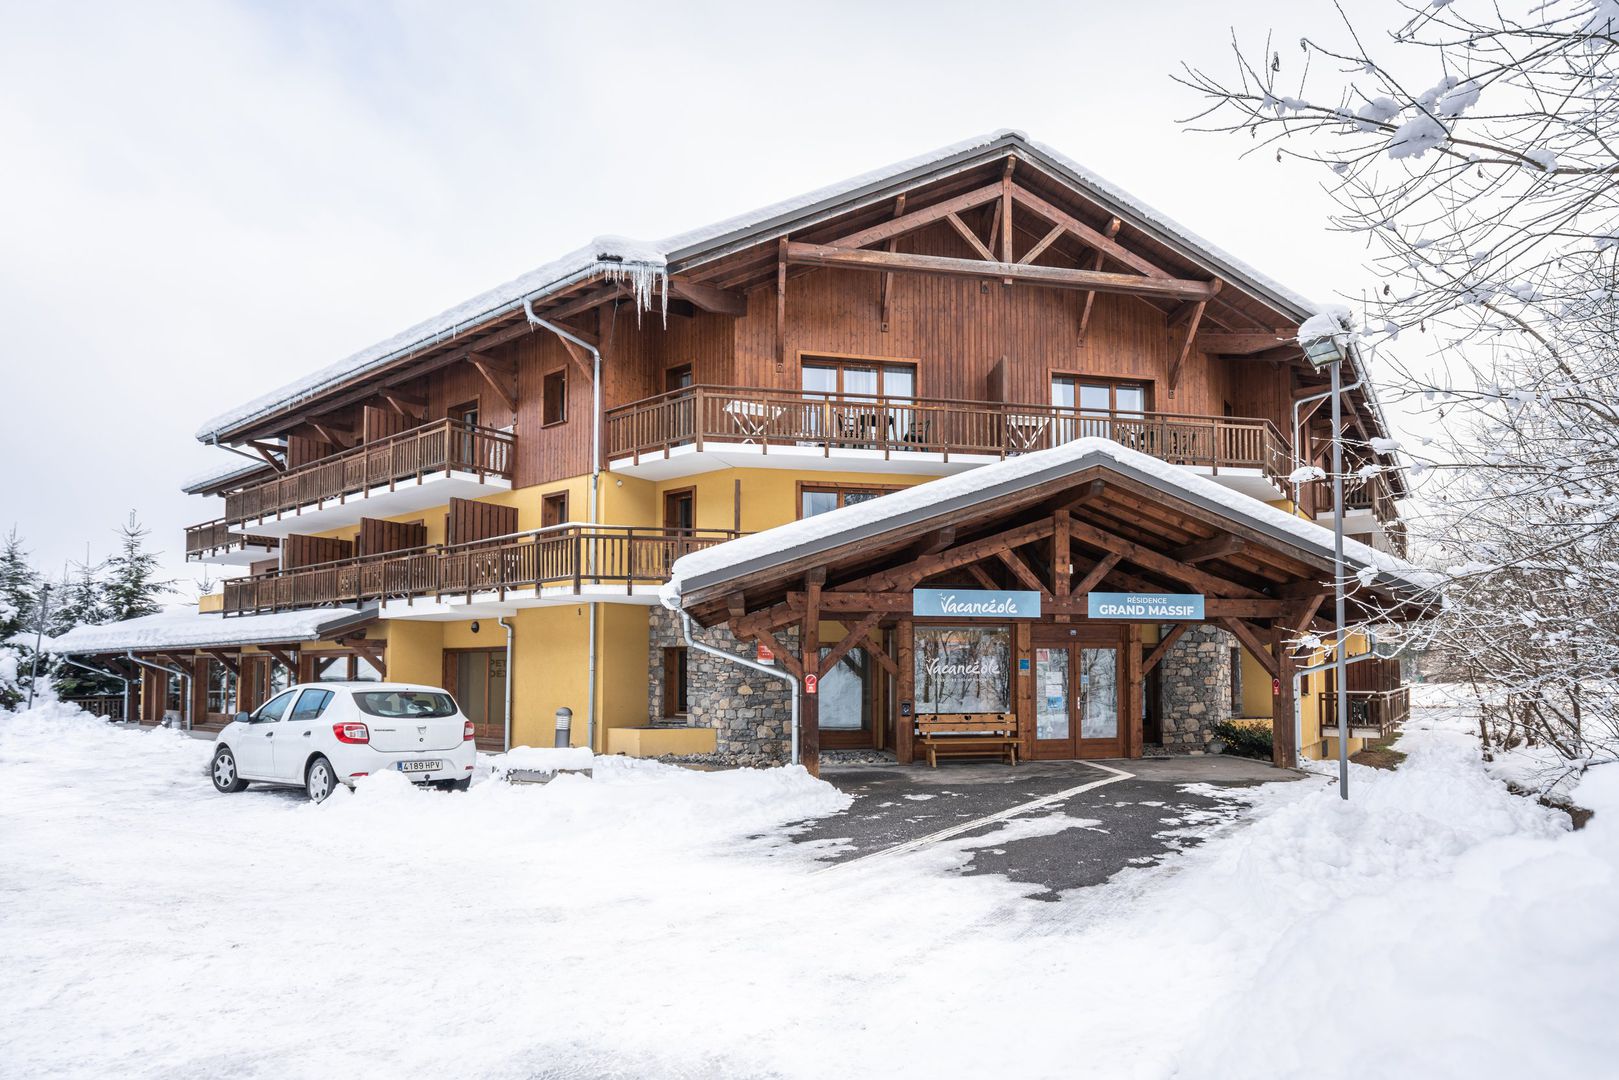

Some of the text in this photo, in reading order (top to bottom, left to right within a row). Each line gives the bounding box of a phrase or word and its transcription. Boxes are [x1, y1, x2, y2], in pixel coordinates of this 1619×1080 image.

[940, 594, 1018, 614] Vacancéole
[1127, 596, 1167, 604] RÉSIDENCE
[1099, 605, 1195, 616] GRAND MASSIF
[925, 657, 1001, 677] Vacancéole
[403, 761, 440, 770] 4189 HPV
